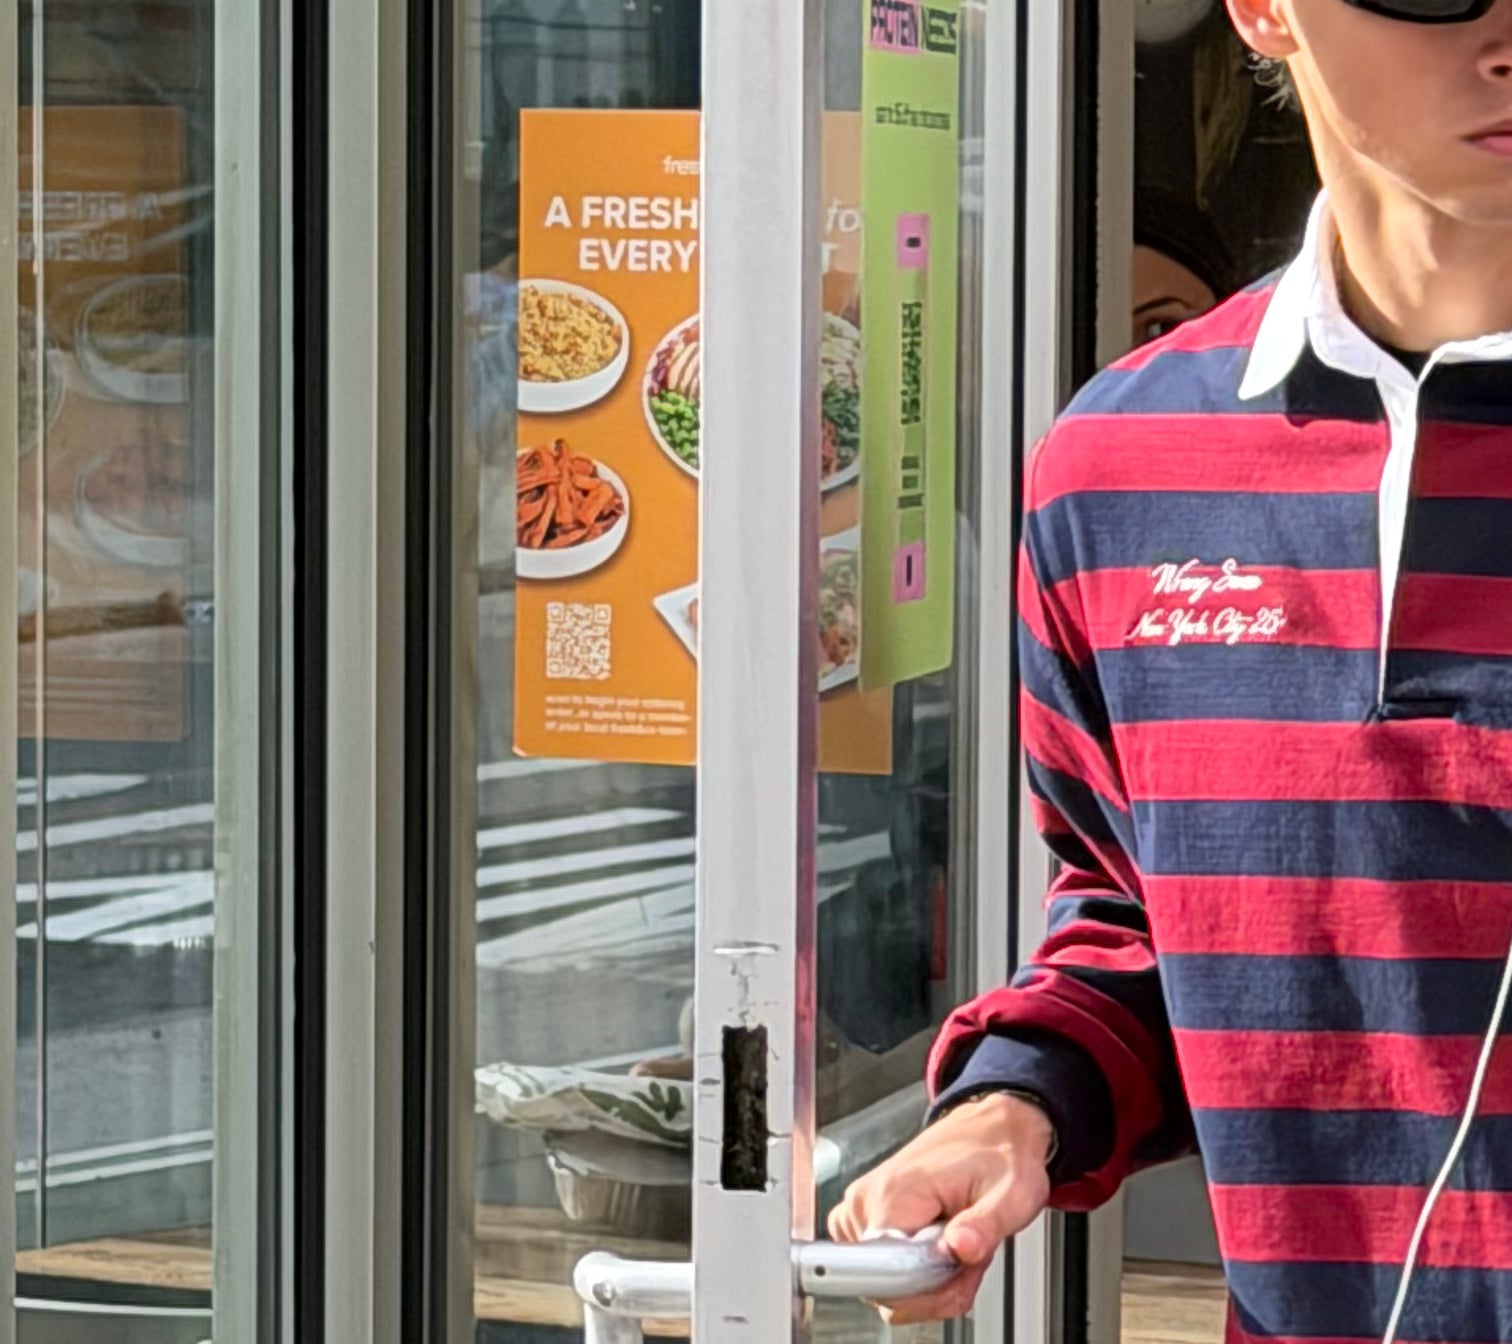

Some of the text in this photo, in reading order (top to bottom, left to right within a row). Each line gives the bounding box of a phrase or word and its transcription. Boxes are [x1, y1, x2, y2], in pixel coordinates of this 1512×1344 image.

[545, 196, 571, 228] A
[582, 197, 698, 230] FRESH
[579, 239, 697, 273] EVERY
